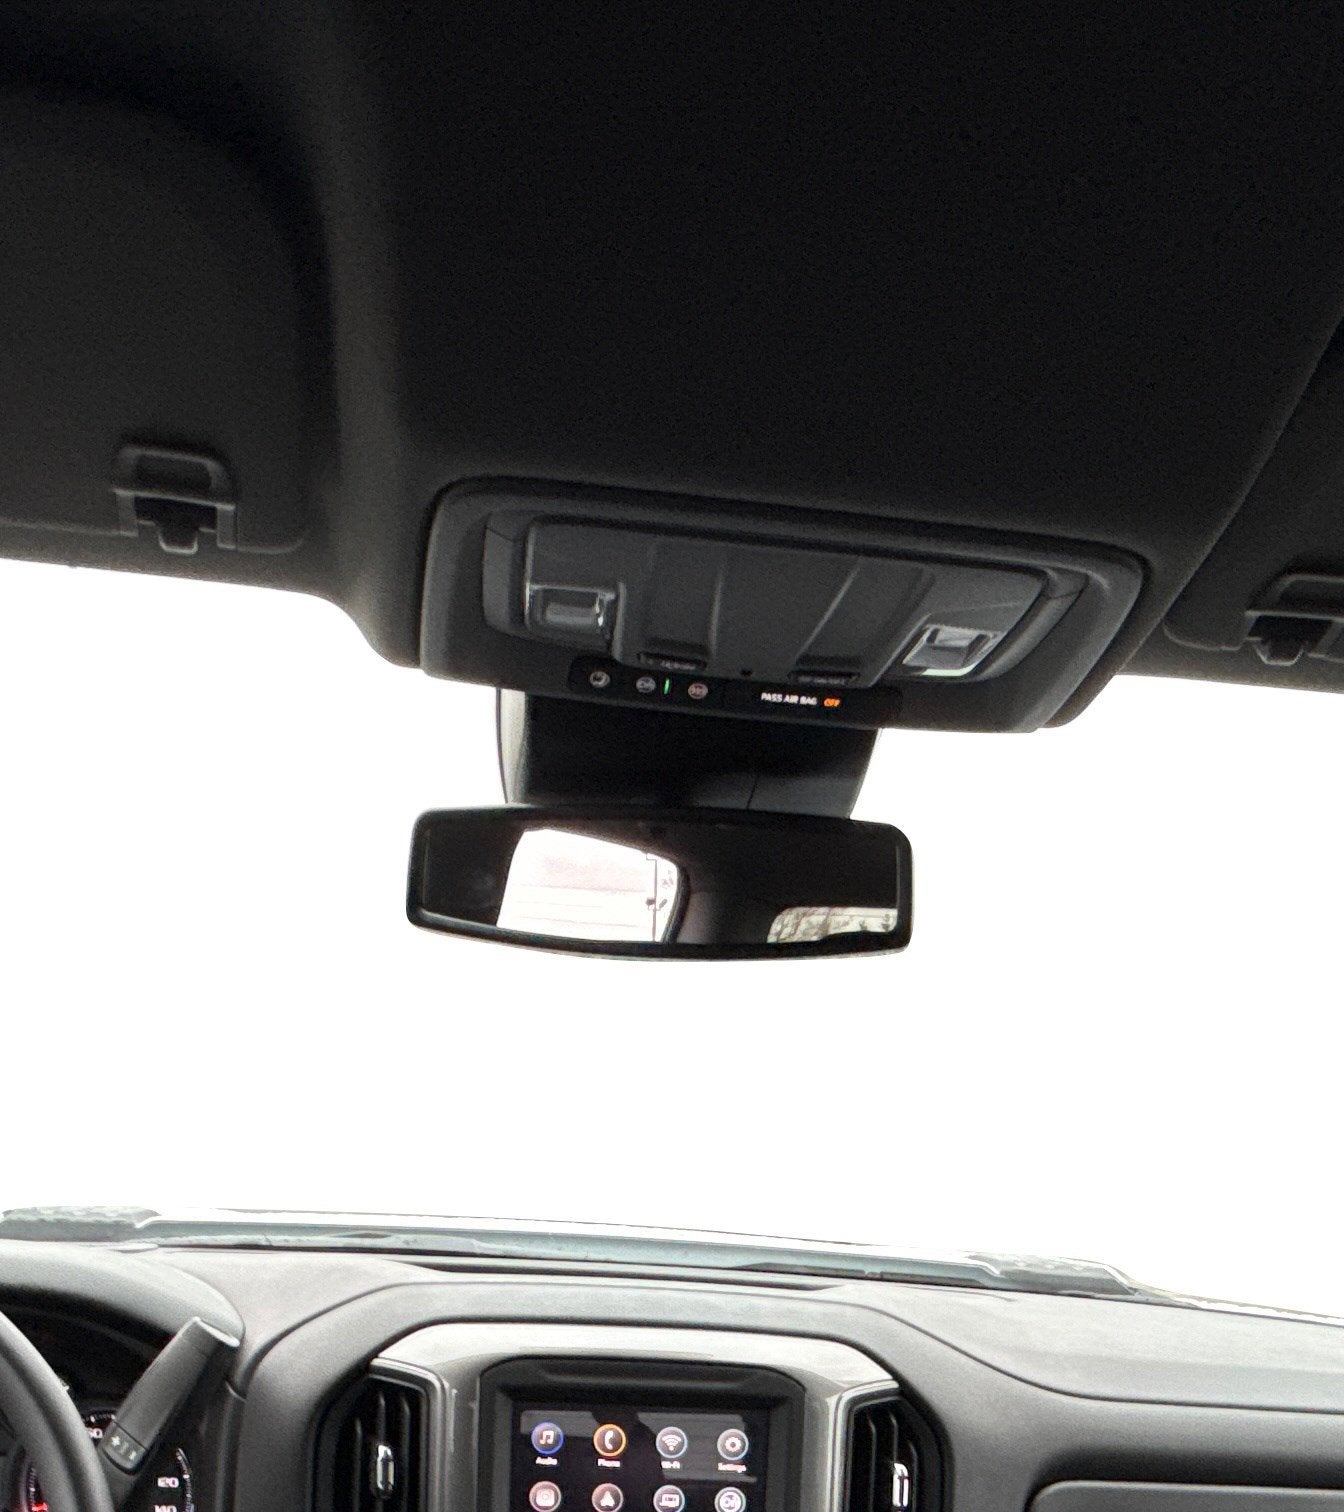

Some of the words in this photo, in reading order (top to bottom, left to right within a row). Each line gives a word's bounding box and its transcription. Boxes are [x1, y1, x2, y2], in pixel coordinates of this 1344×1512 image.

[761, 692, 783, 702] PASS
[783, 694, 799, 704] AIR
[799, 696, 817, 705] BAG
[824, 698, 840, 707] OFF
[535, 1456, 558, 1466] Audio
[597, 1458, 621, 1467] Phone
[660, 1460, 680, 1469] Wi-Fi
[717, 1462, 747, 1473] Settings
[157, 1477, 179, 1488] 120
